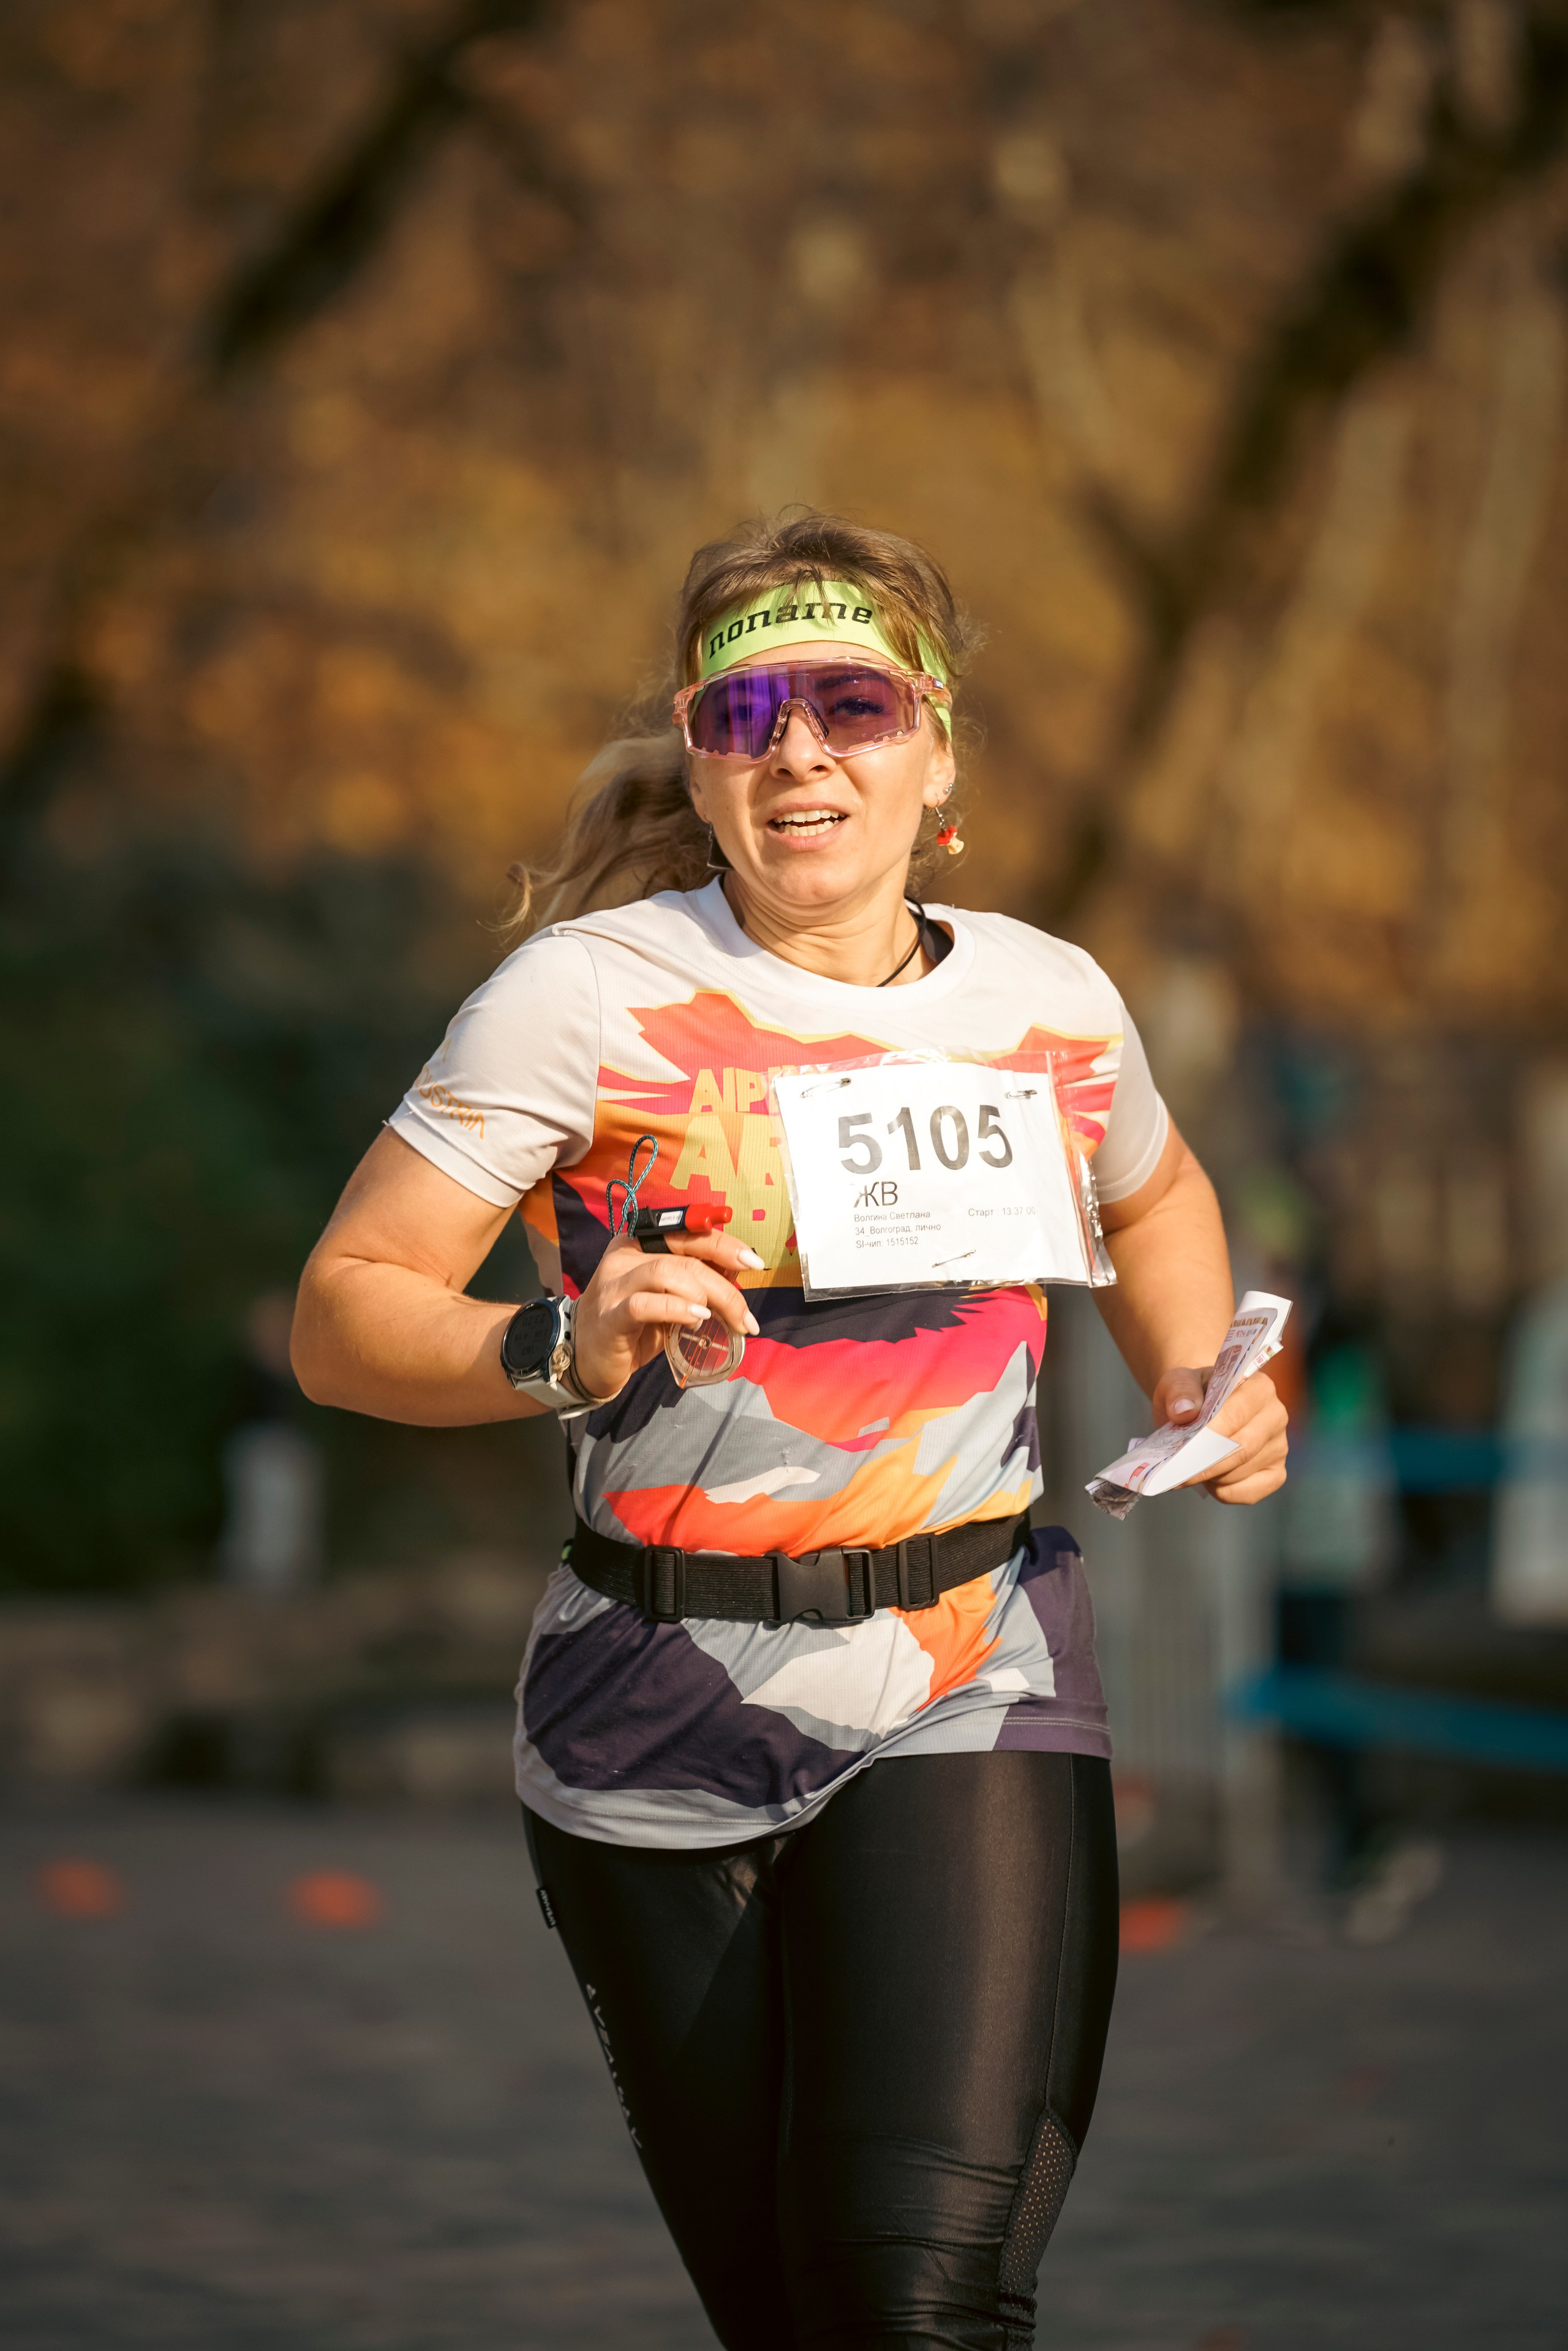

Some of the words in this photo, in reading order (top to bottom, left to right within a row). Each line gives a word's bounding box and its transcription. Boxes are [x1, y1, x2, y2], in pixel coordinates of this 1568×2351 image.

[709, 602, 873, 659] noname
[874, 725, 903, 739] photochromic
[837, 1104, 1013, 1175] 5105
[853, 1181, 899, 1208] ЖВ
[854, 1213, 888, 1222] Волгина
[889, 1211, 931, 1220] Светлана
[968, 1208, 994, 1218] Старт
[886, 1236, 919, 1247] 1515152
